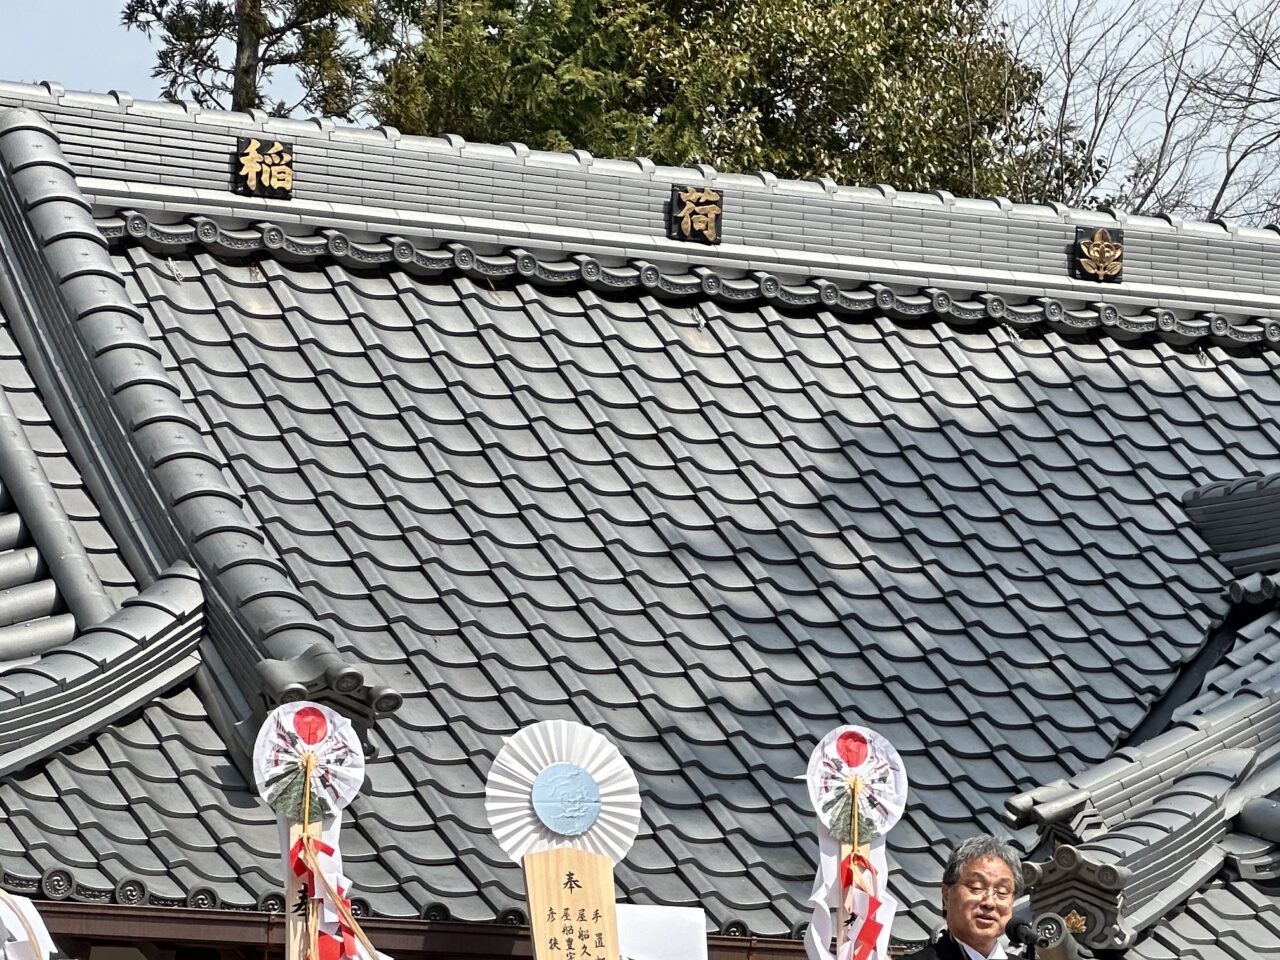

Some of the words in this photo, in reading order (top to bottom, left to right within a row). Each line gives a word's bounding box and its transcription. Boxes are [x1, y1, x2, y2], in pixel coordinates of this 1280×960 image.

[239, 138, 293, 190] 稲
[677, 186, 722, 241] 荷
[562, 870, 583, 895] 奉
